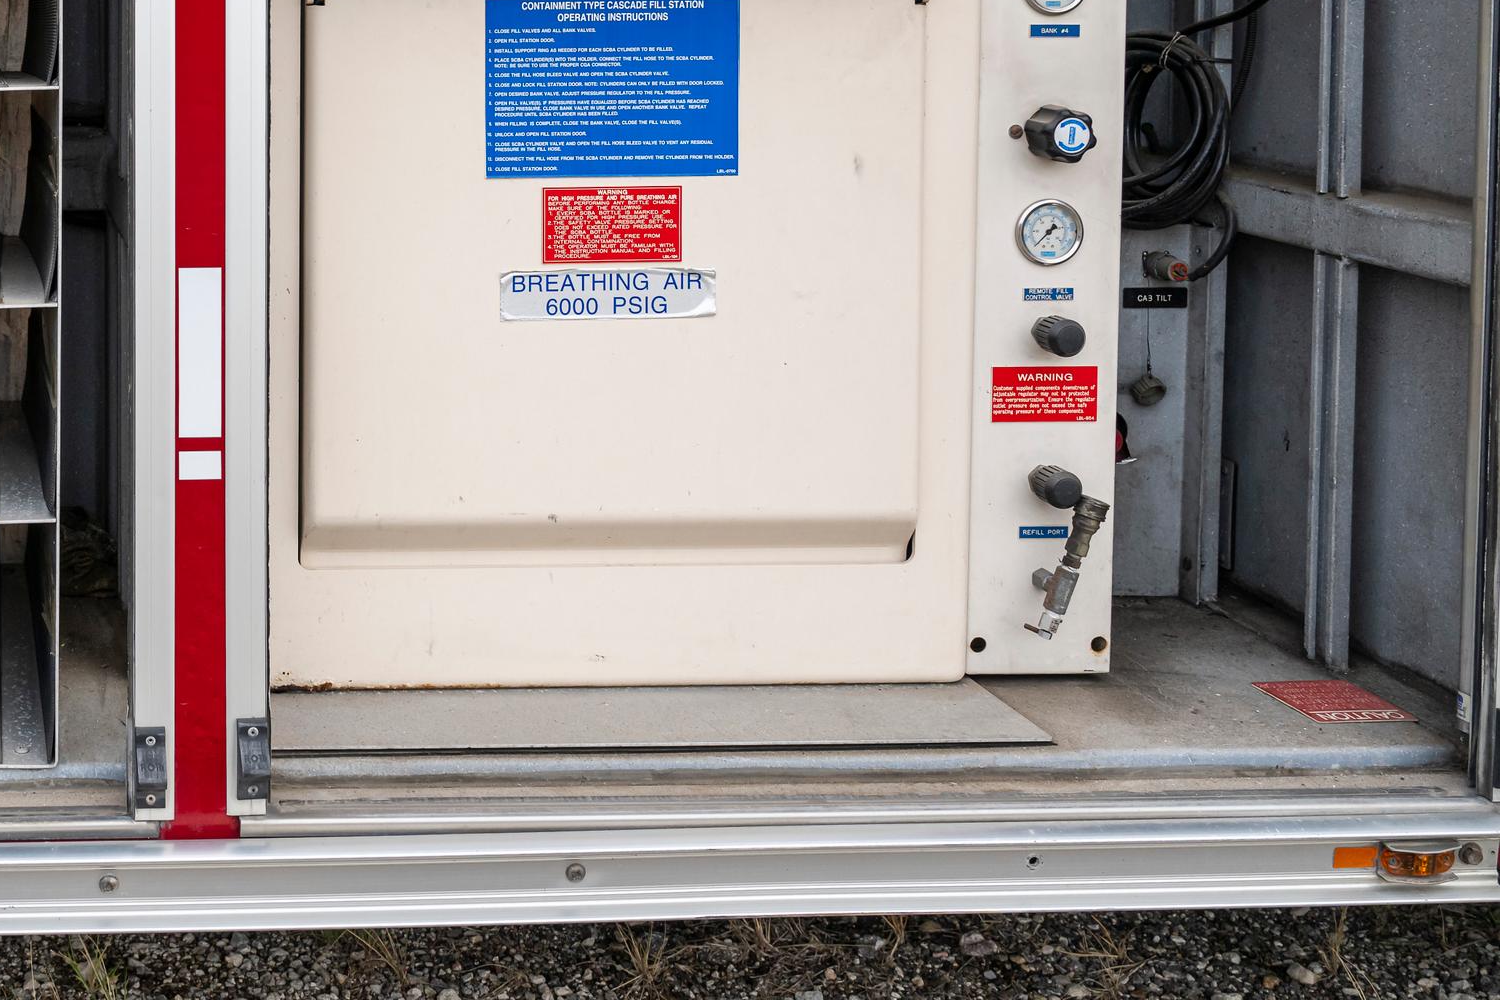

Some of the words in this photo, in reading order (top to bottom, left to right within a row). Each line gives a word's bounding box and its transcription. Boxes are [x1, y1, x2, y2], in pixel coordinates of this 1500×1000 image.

[522, 1, 582, 10] CONTAINMENT
[584, 1, 605, 10] TYPE
[607, 0, 647, 9] CASCADE
[649, 0, 667, 9] FILL
[668, 0, 704, 9] STATION
[557, 13, 606, 22] OPERATING
[608, 12, 669, 21] INSTRUCTIONS
[512, 273, 649, 293] BREATHING
[663, 273, 702, 290] AIR
[546, 298, 598, 316] 6000
[613, 296, 668, 314] PSIG
[1018, 373, 1073, 381] WARNING
[1316, 711, 1405, 721] CAUTION
